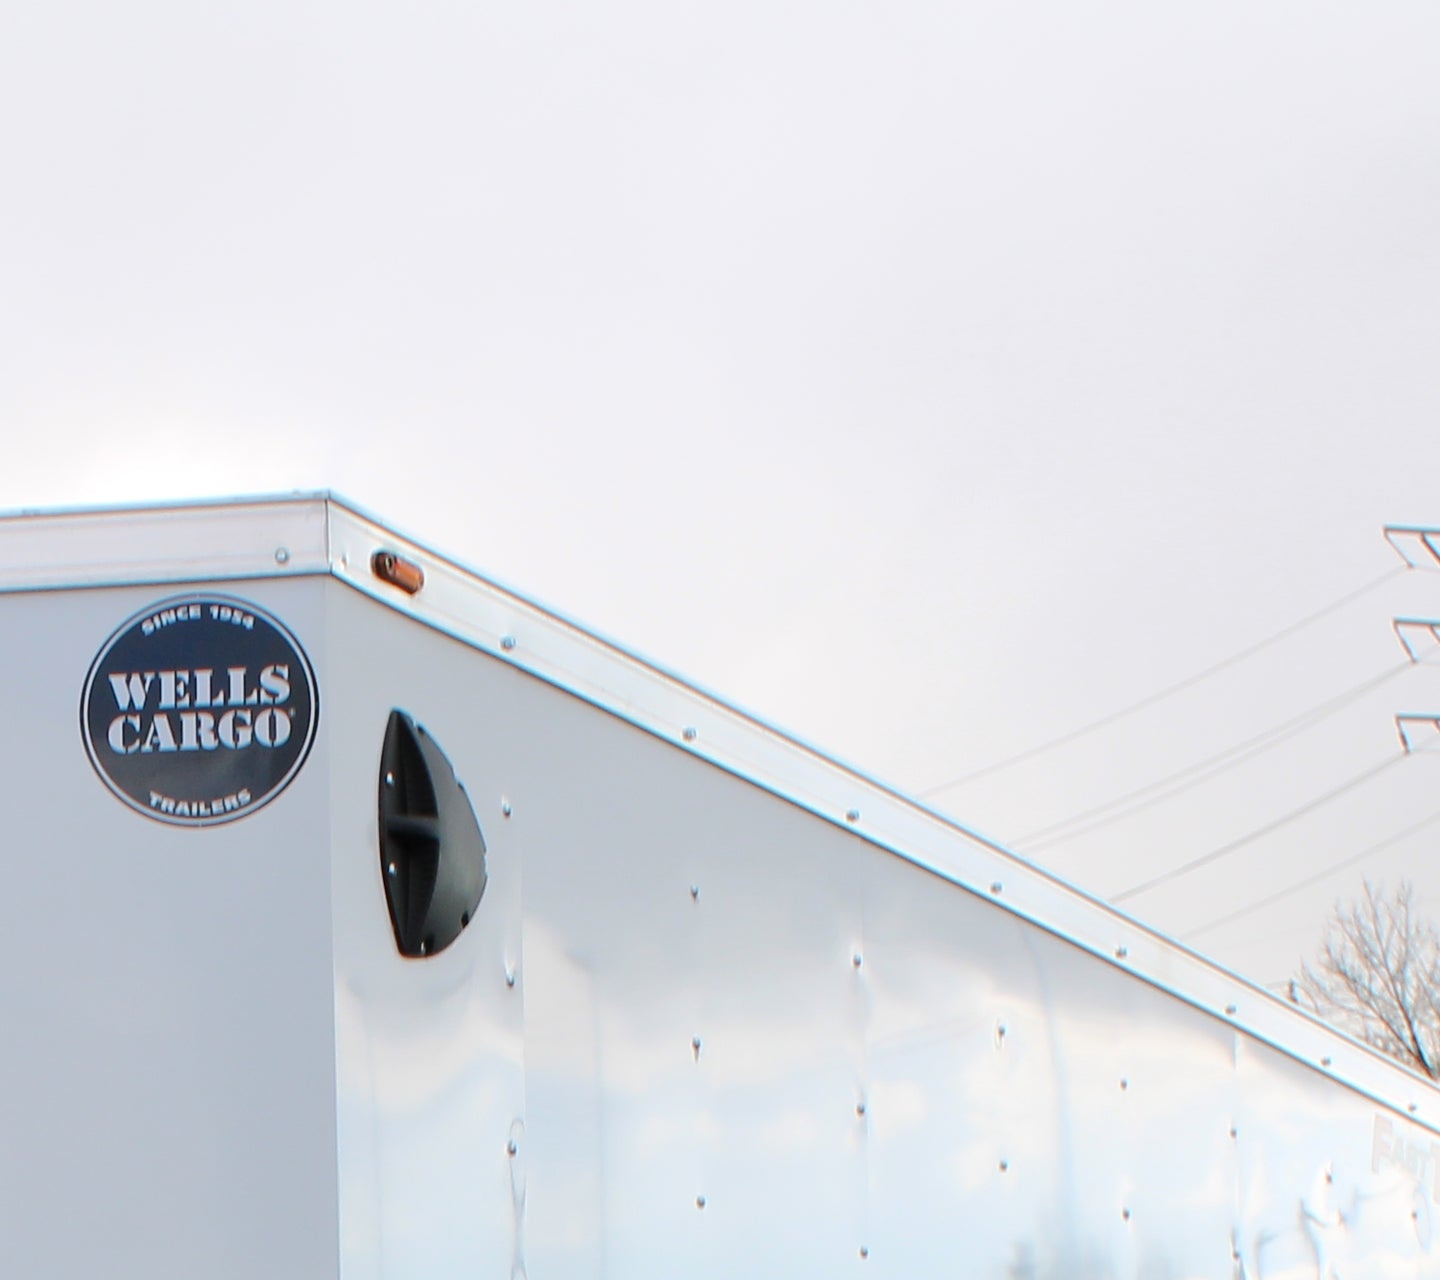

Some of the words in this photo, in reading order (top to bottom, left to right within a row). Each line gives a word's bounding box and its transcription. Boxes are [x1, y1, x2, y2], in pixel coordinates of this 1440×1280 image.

[141, 604, 201, 636] SINCE
[210, 604, 255, 631] 1954
[108, 664, 291, 710] WELLS
[107, 708, 292, 755] CARGO
[149, 788, 251, 817] TRAILERS
